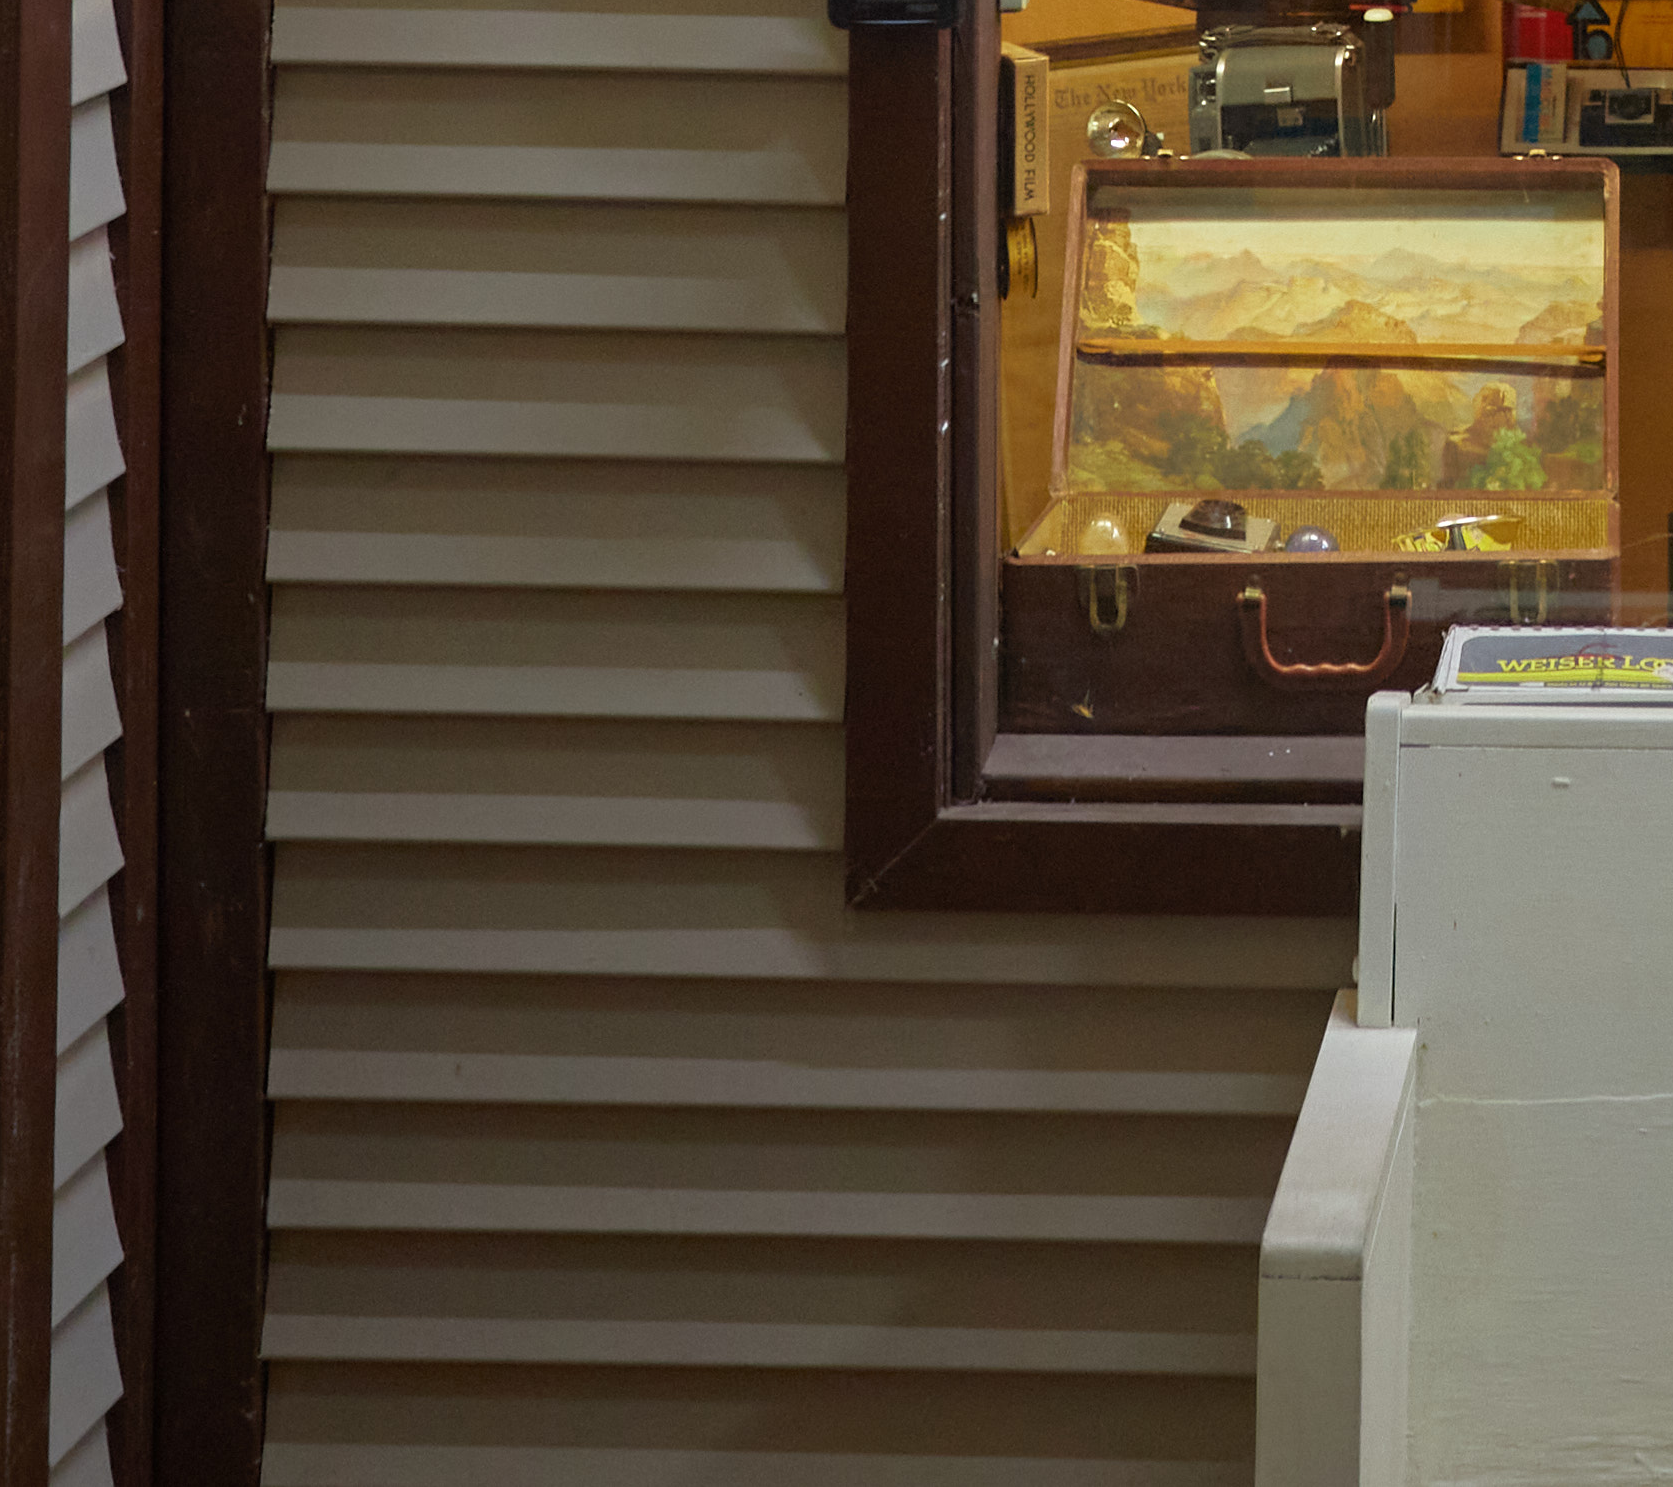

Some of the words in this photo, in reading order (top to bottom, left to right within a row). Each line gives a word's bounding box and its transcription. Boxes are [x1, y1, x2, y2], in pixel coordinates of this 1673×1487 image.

[1023, 74, 1037, 163] HOLLYWOOD
[1023, 167, 1036, 203] FILM
[1497, 656, 1611, 676] WEISER
